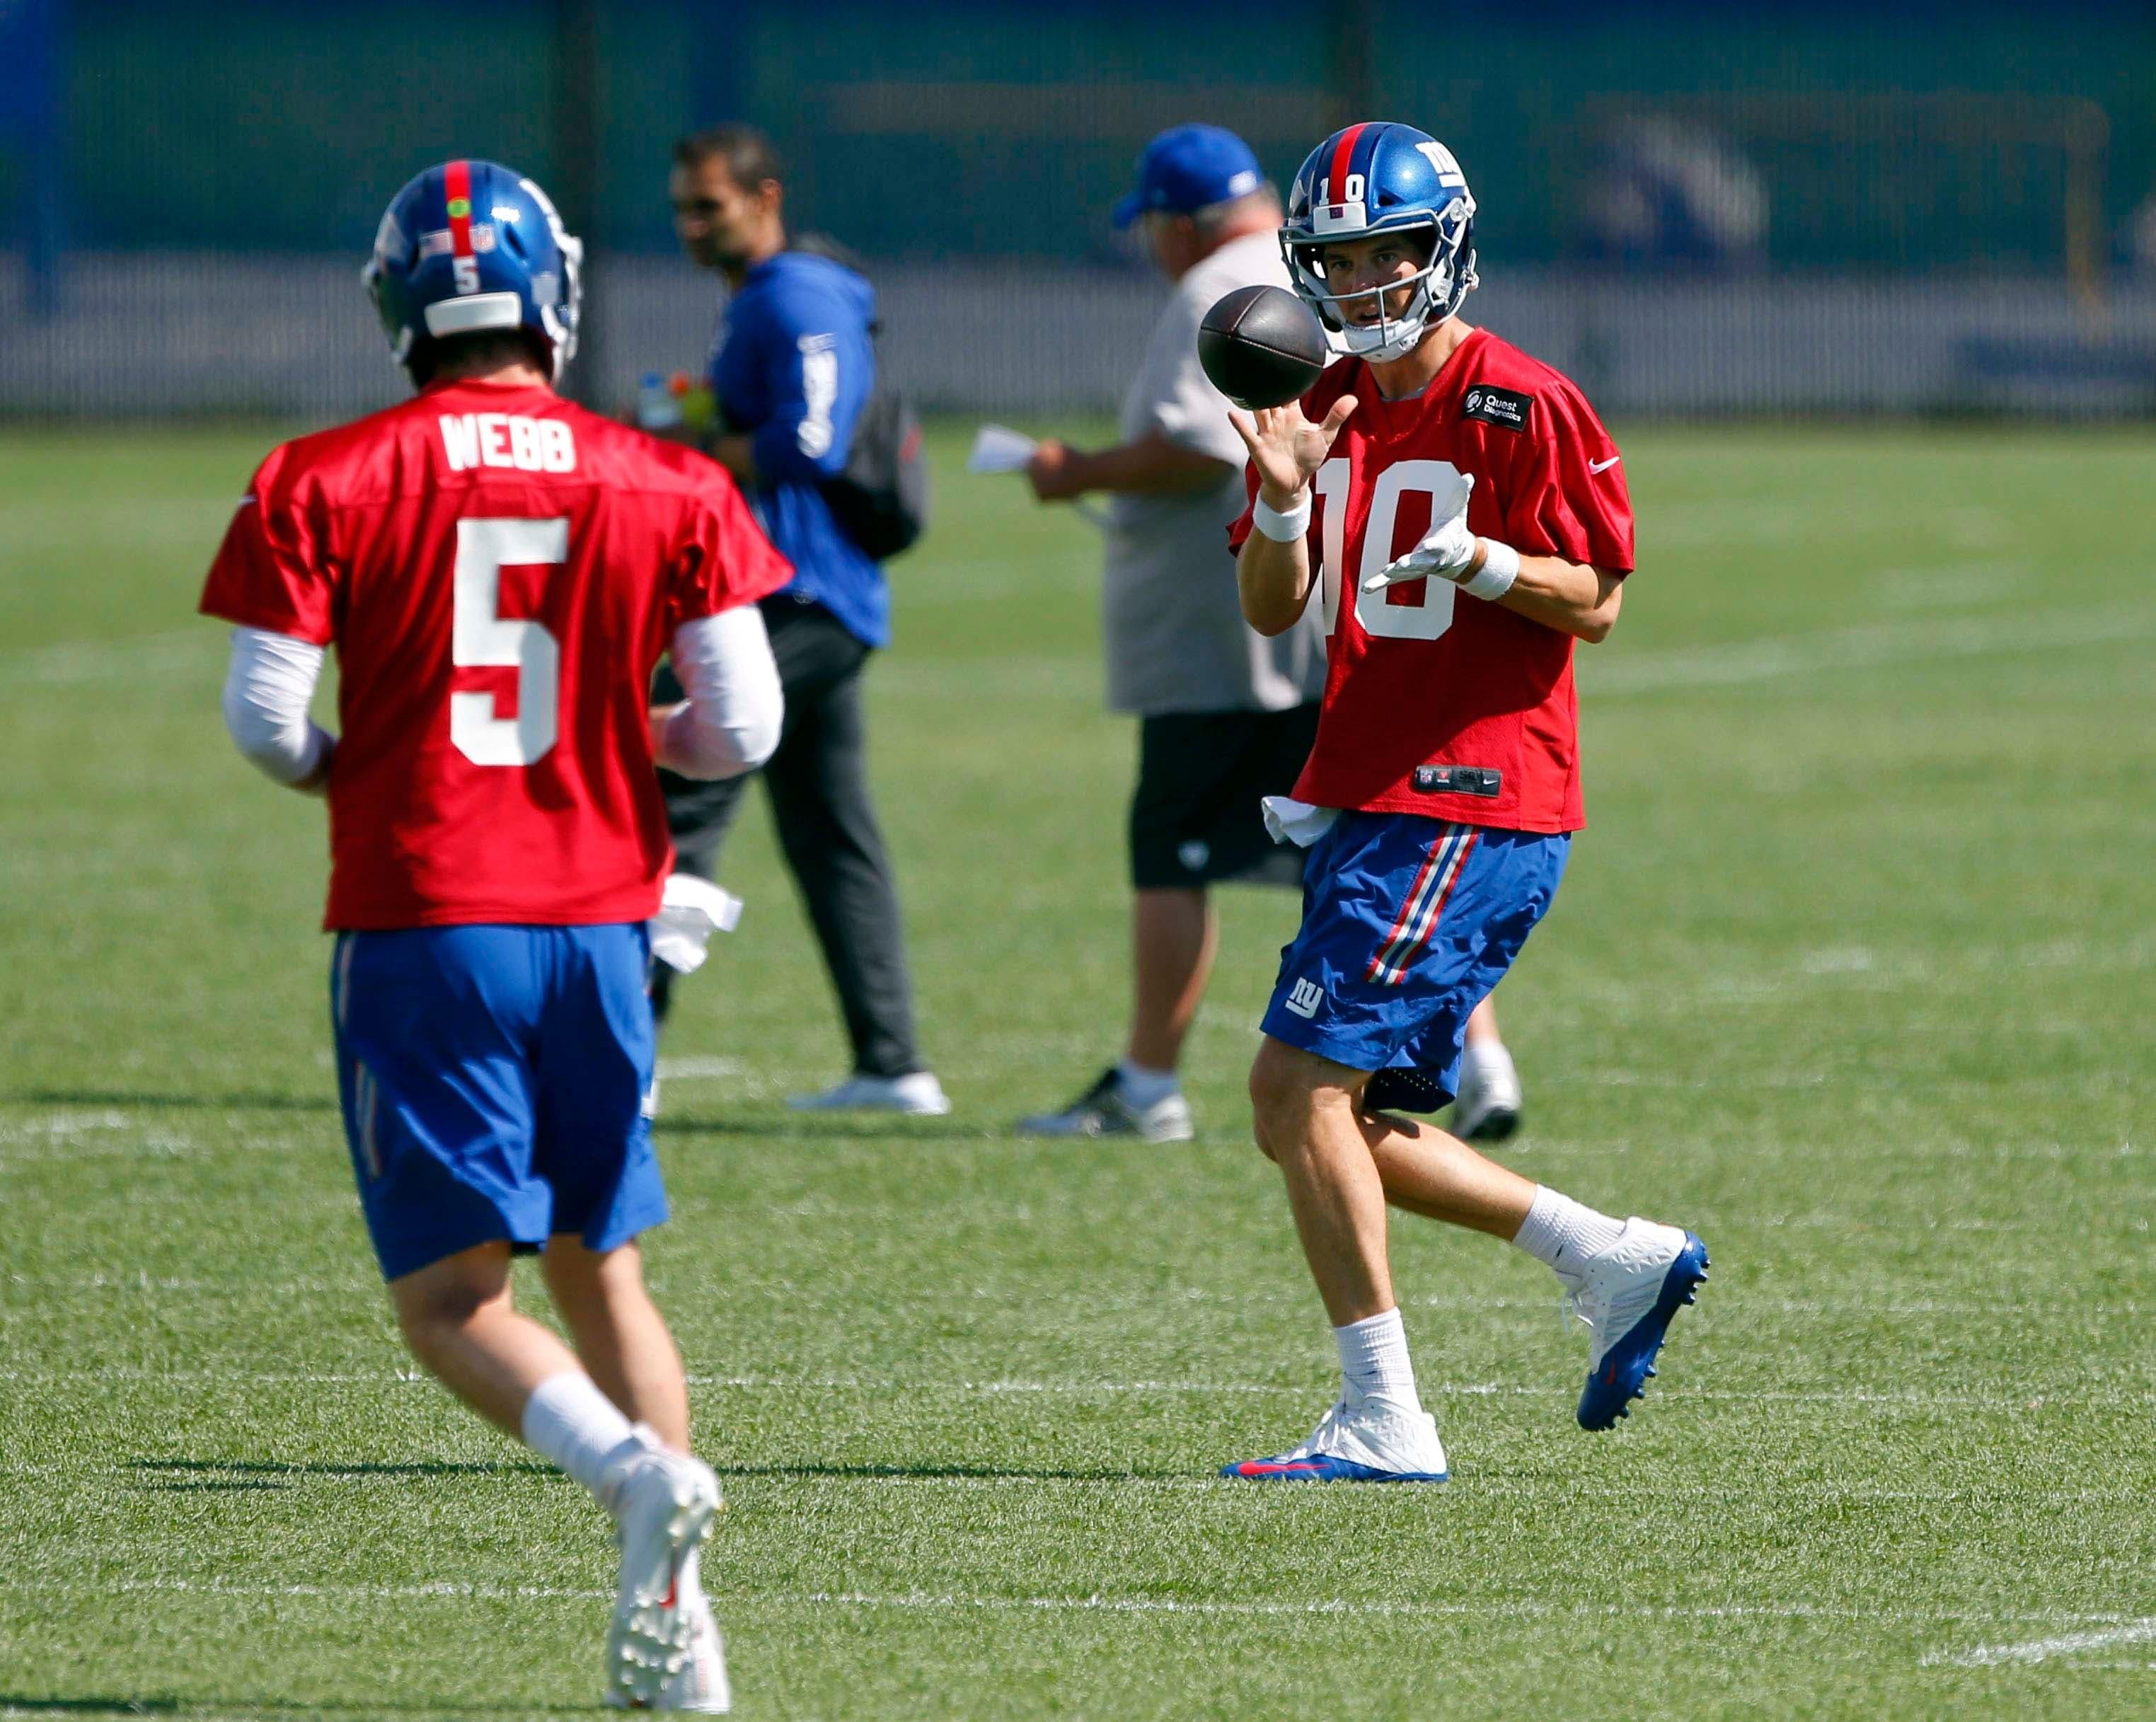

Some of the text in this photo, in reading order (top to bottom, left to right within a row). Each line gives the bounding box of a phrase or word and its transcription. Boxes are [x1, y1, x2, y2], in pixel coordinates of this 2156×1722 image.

[452, 255, 480, 294] 5
[1486, 395, 1517, 411] Quest
[439, 412, 577, 473] WEBB
[1315, 457, 1469, 641] 10
[450, 517, 570, 766] 5
